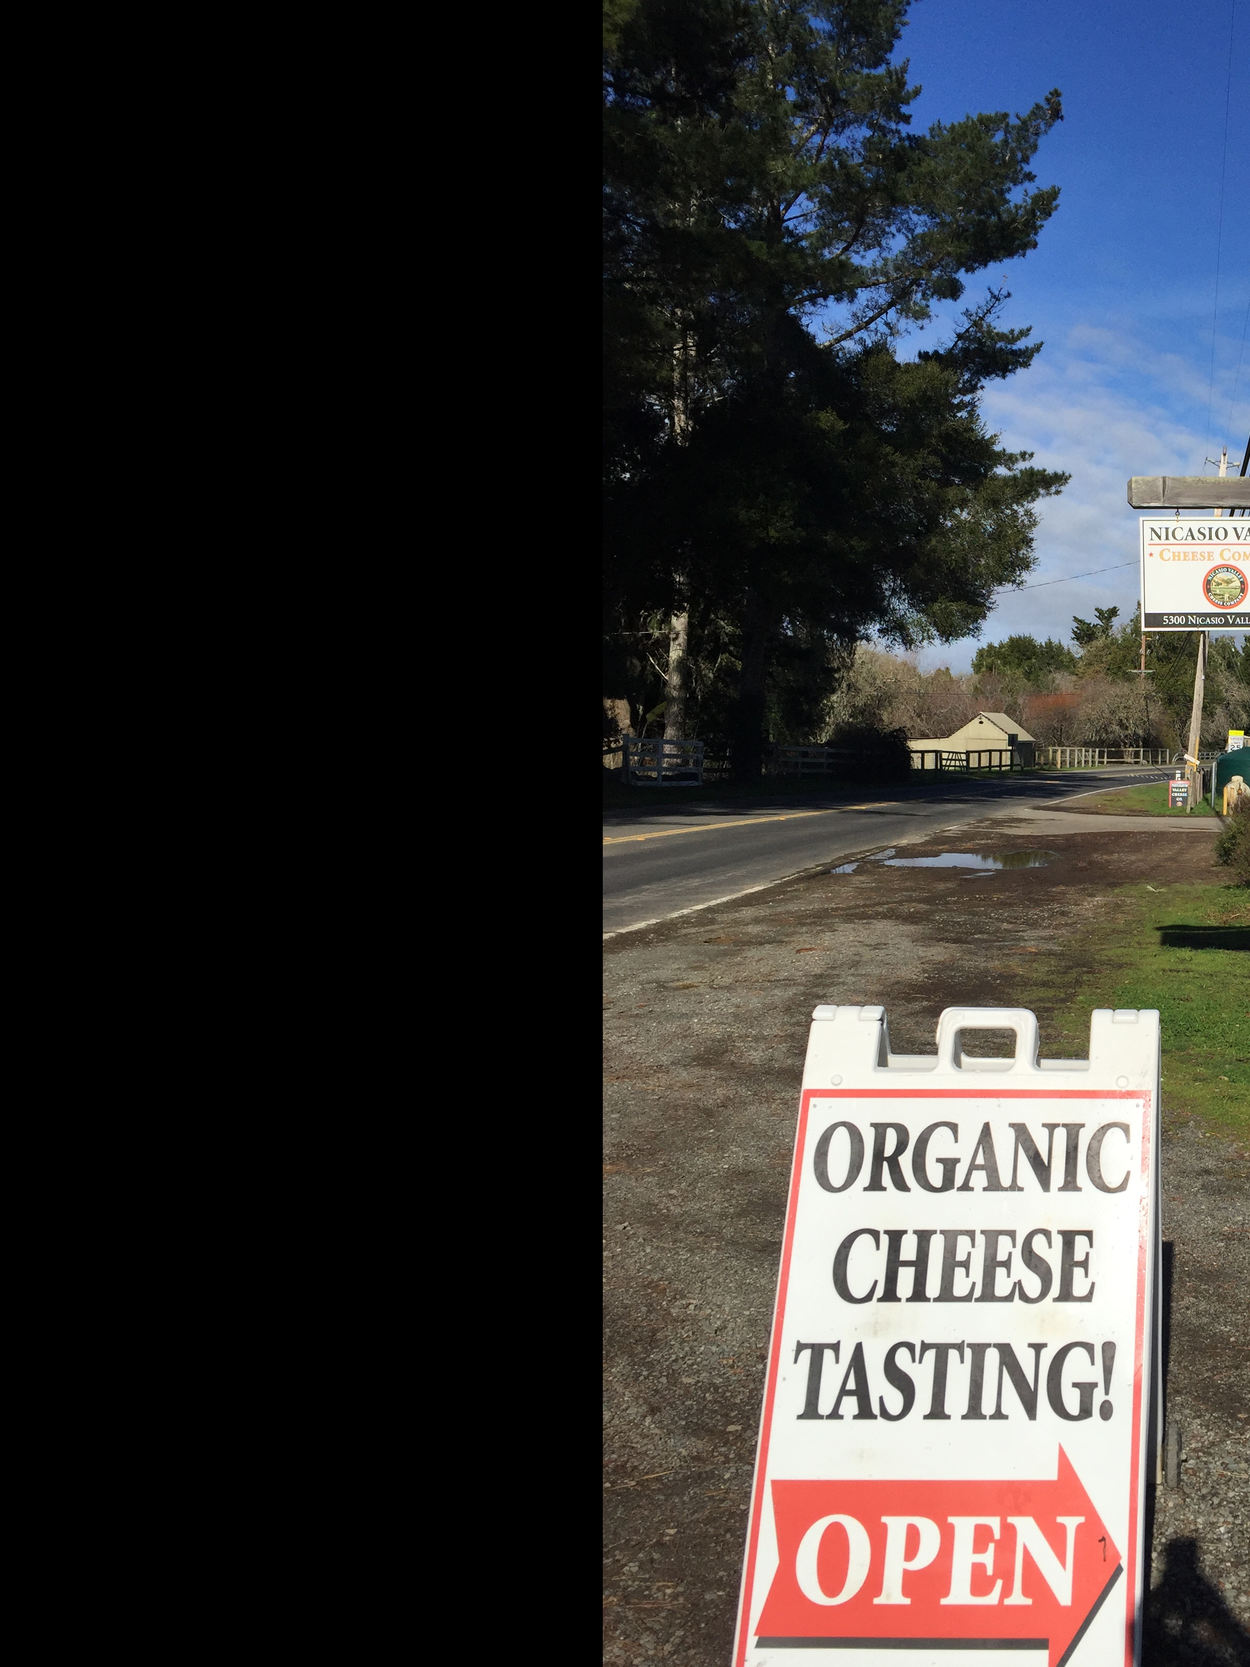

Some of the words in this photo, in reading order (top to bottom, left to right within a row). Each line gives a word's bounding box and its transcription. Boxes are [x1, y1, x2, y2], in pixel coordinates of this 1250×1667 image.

[1149, 526, 1228, 541] NICASIO
[1159, 548, 1215, 562] CHEESE
[1208, 567, 1228, 580] NICASIO
[1228, 567, 1244, 581] VALLEY
[1208, 592, 1223, 606] CHEESE
[1223, 592, 1244, 606] COMPANY
[1162, 615, 1186, 625] 5300
[1188, 615, 1225, 625] NICASIO
[813, 1121, 1131, 1194] ORGANIC
[832, 1228, 1095, 1304] CHEESE
[793, 1340, 1117, 1422] TASTING!
[796, 1514, 1086, 1606] OPEN
